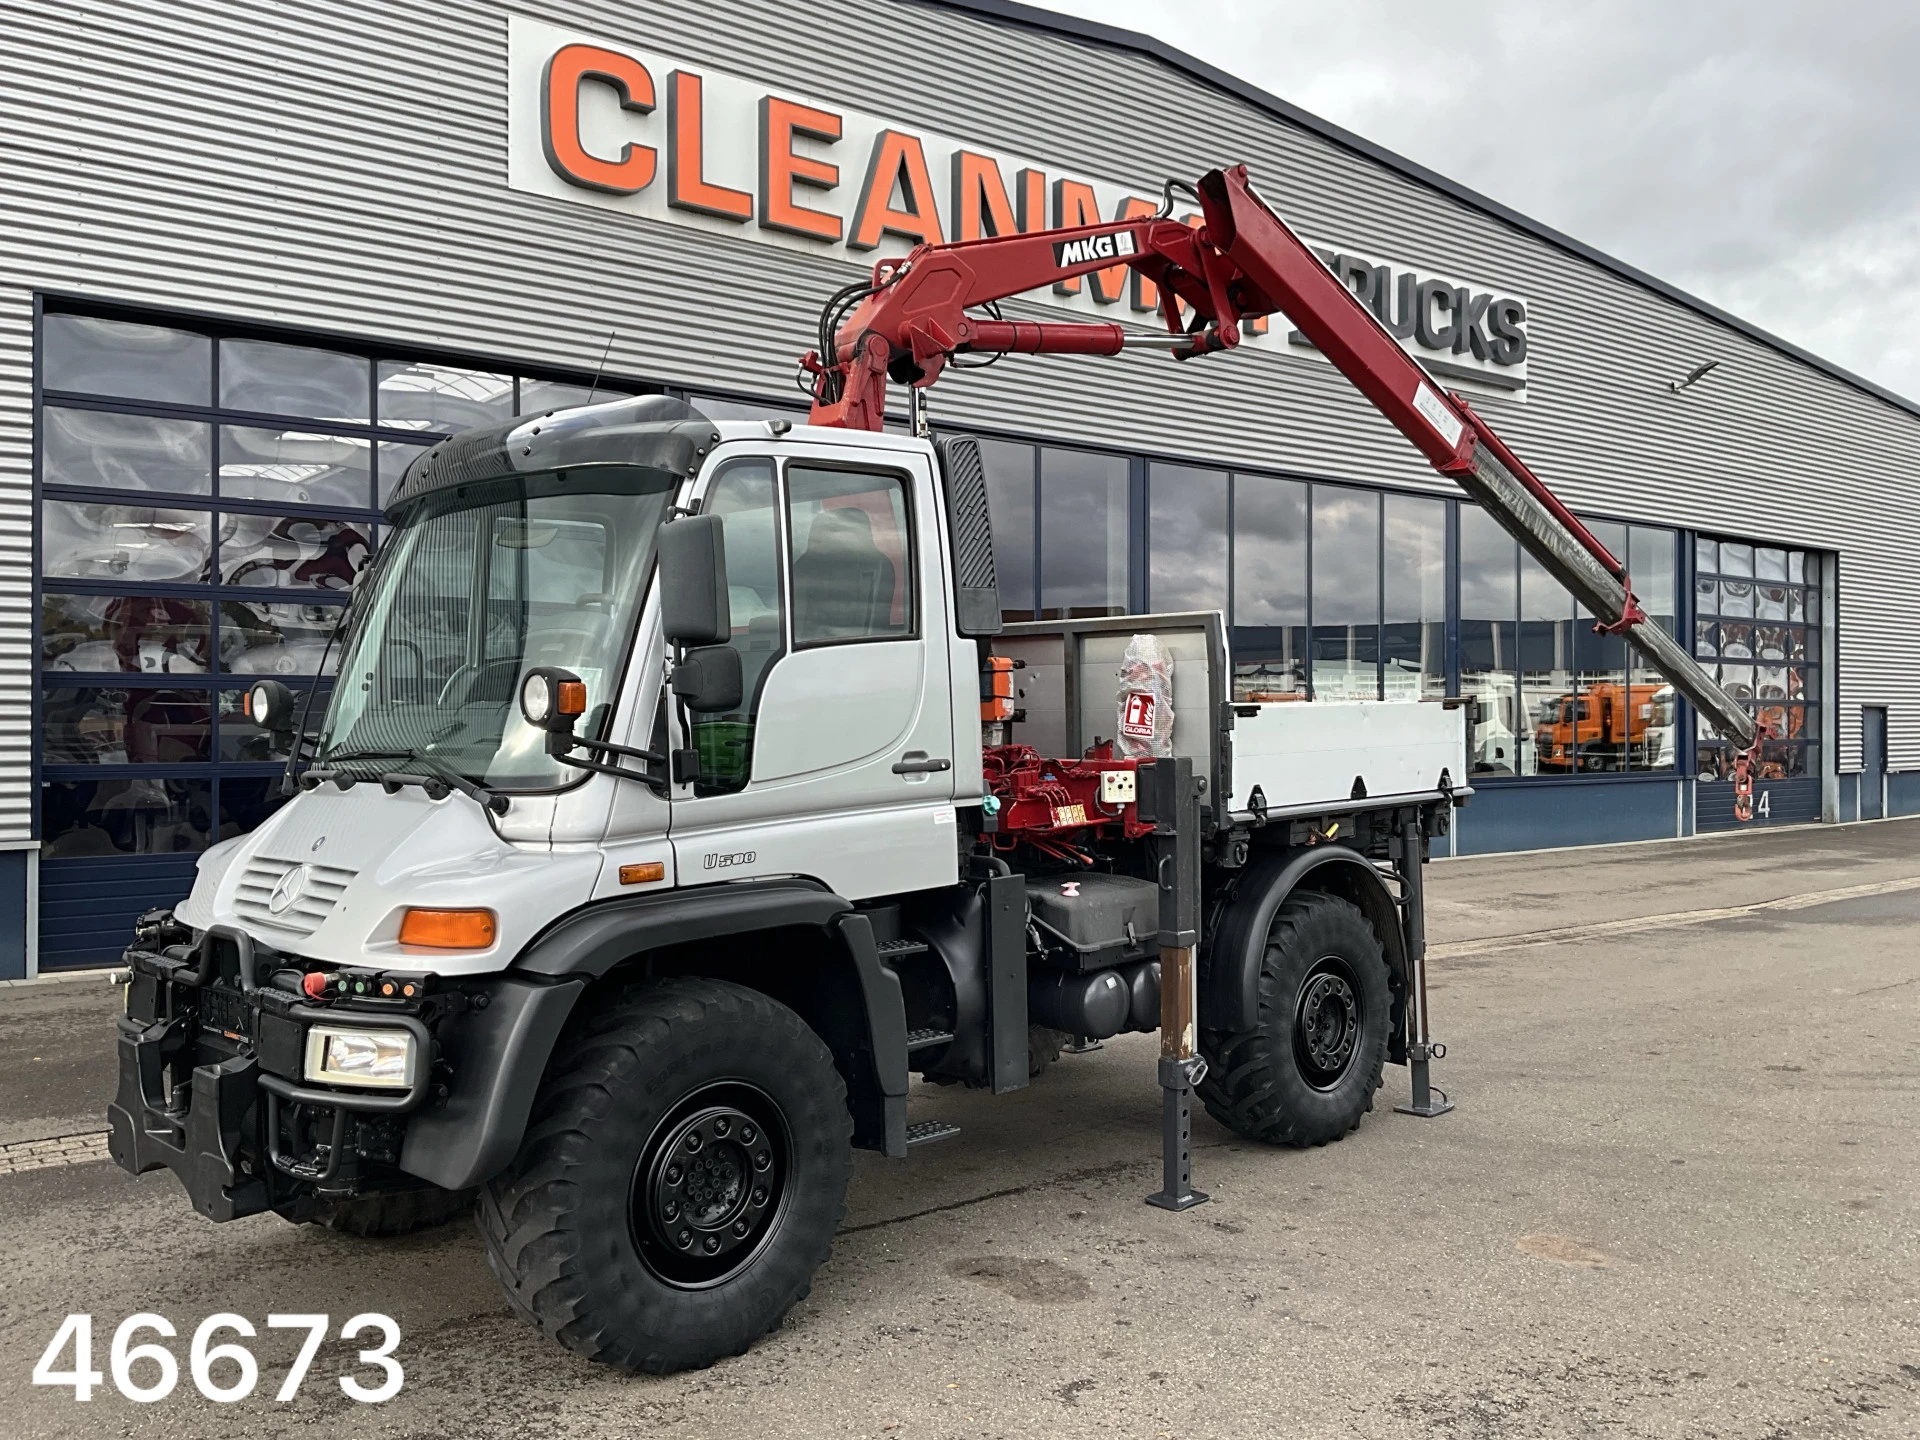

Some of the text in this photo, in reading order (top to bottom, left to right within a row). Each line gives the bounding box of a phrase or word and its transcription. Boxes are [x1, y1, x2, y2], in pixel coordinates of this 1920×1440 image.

[540, 43, 1269, 337] CLEANM
[1061, 235, 1114, 268] MKG
[1125, 726, 1152, 735] GLORIA
[703, 851, 756, 870] U 500
